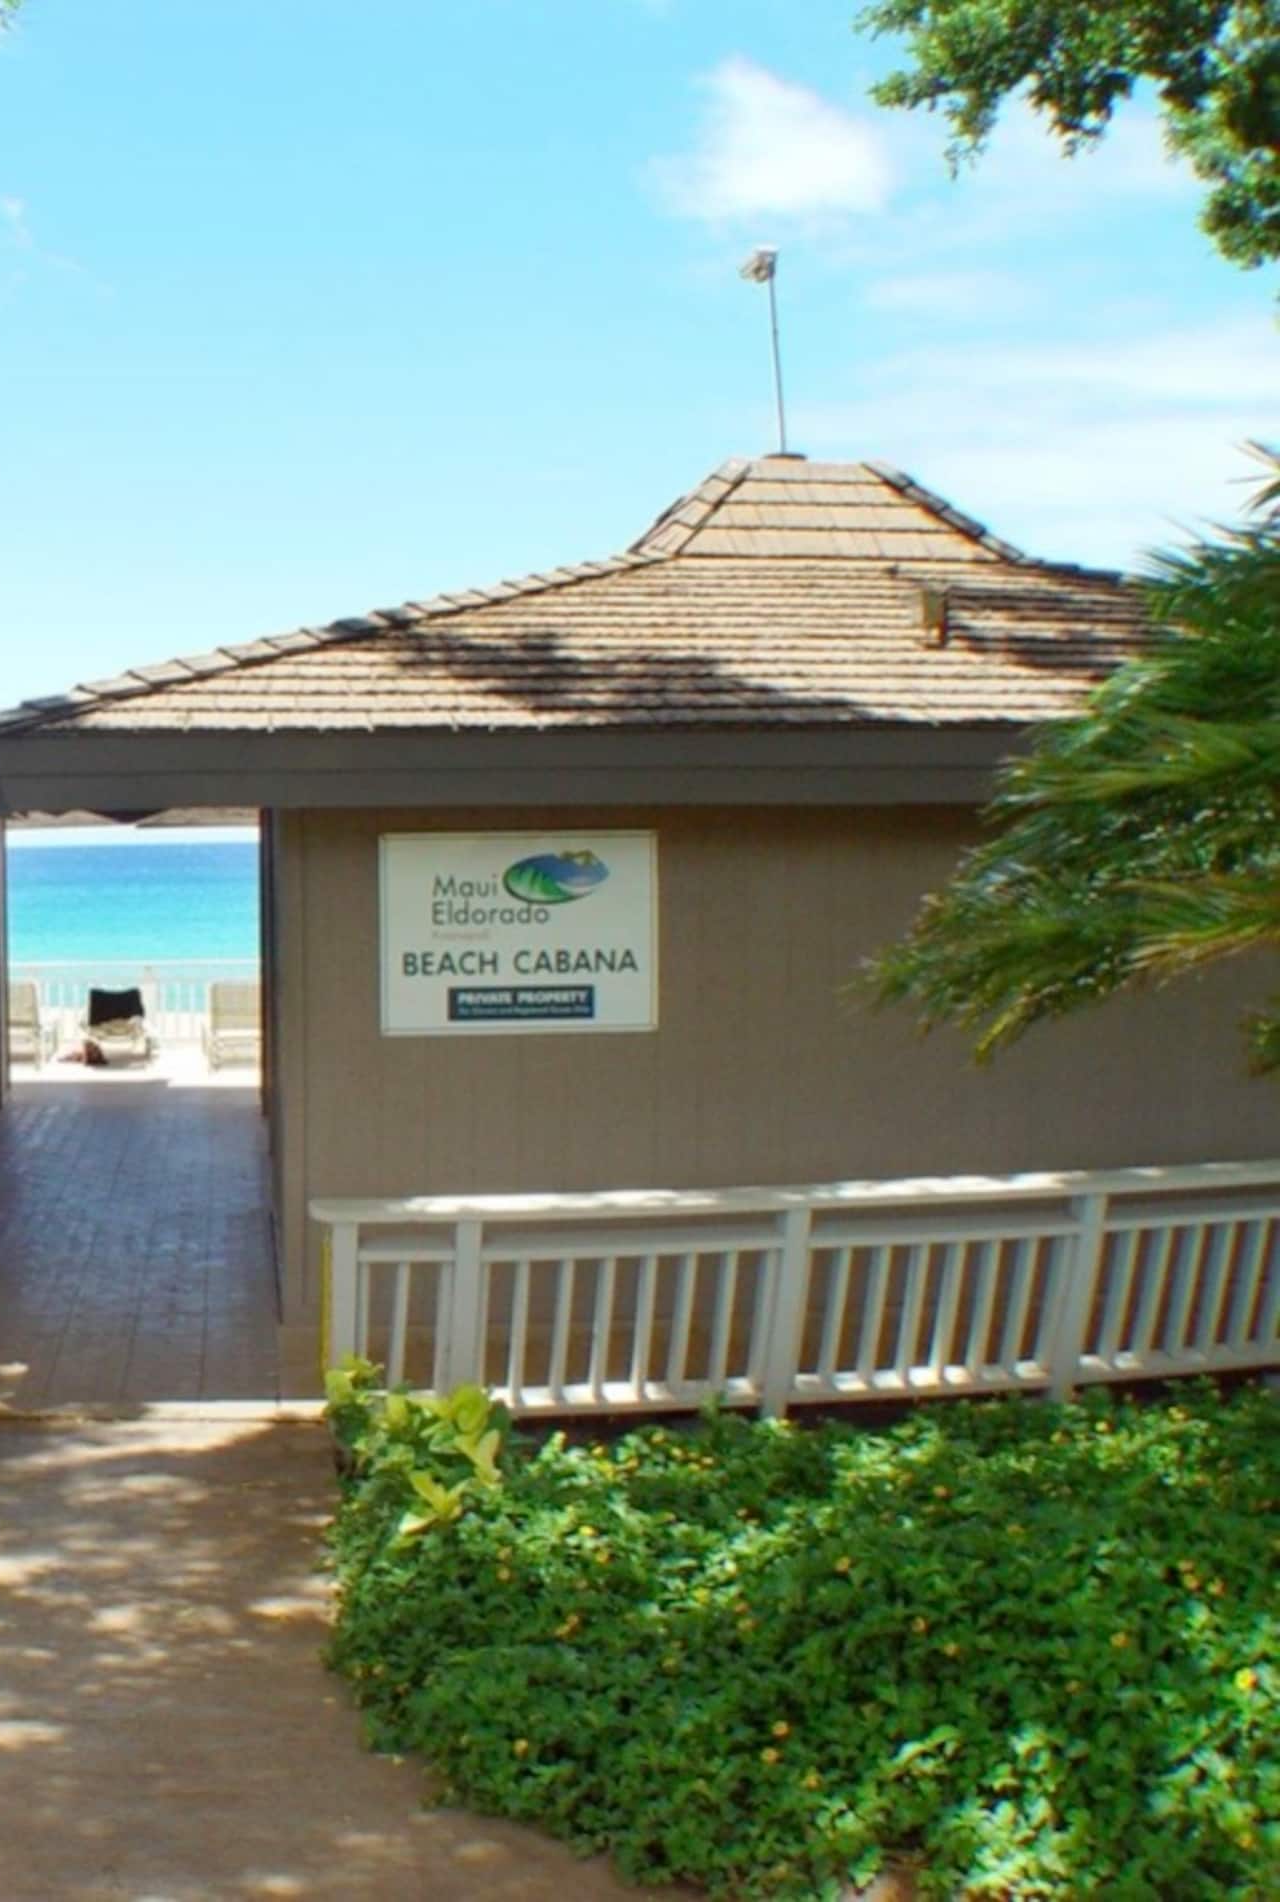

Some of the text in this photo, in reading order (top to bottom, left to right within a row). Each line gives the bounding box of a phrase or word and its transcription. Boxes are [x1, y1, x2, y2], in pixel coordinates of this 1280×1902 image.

[432, 873, 498, 898] Maui
[431, 900, 551, 925] Eldorado
[402, 948, 639, 976] BEACH CABANA
[457, 990, 588, 1005] PRIVATE PROPERTY
